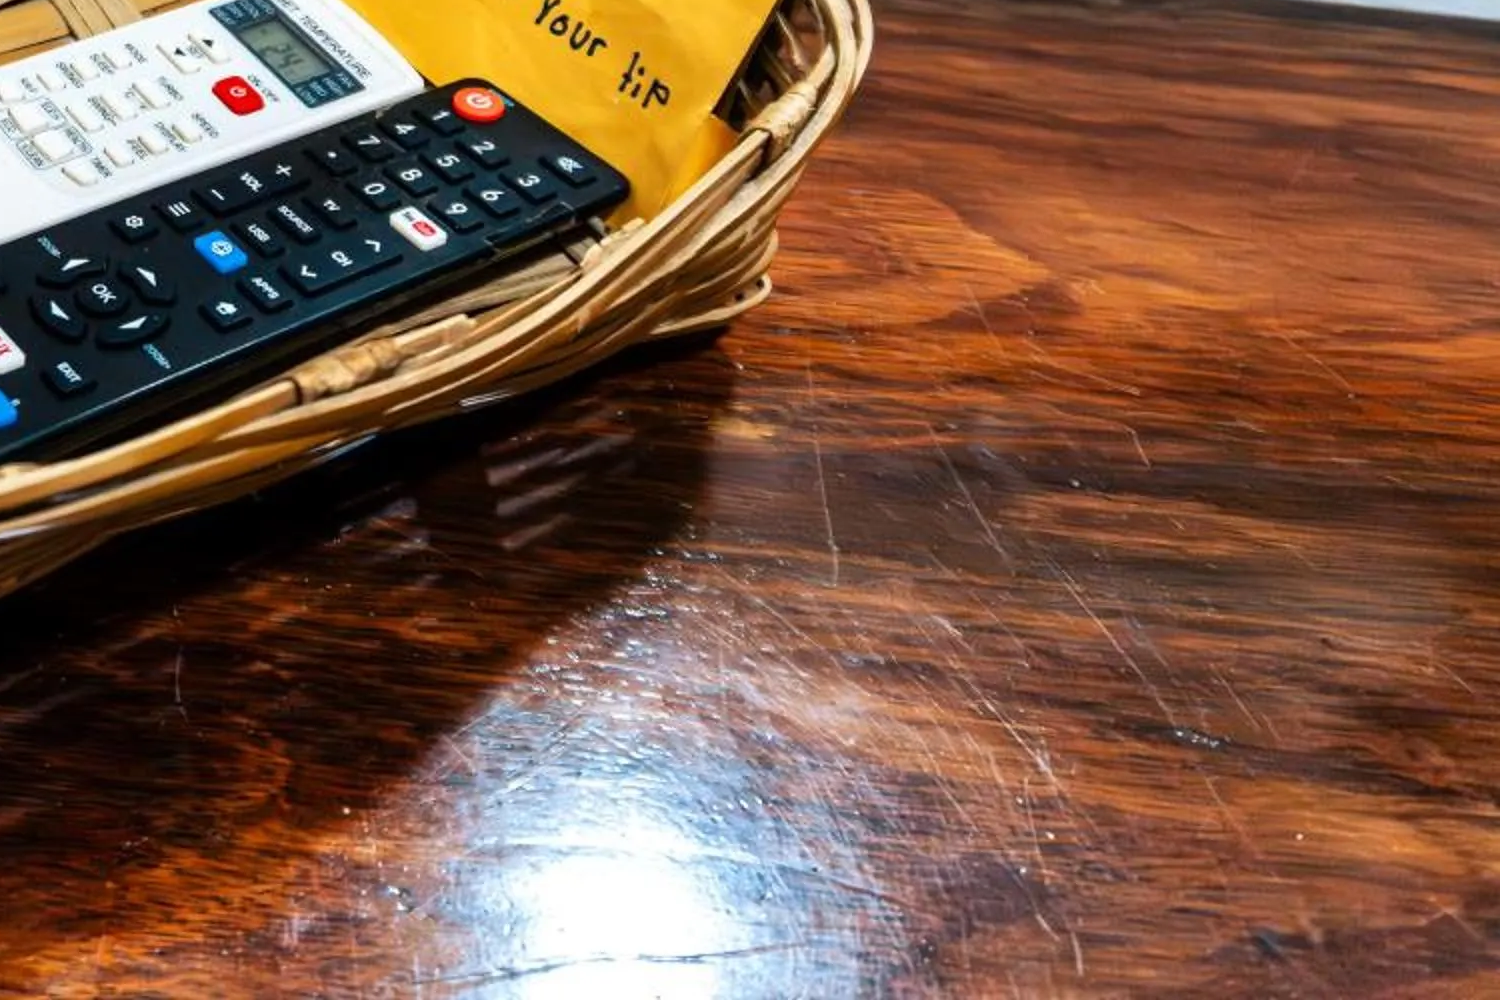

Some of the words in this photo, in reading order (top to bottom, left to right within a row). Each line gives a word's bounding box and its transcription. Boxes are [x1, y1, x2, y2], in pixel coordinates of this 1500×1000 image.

[300, 15, 372, 79] TEMPERATURE
[432, 110, 450, 122] 1
[396, 123, 416, 135] 4
[357, 134, 381, 146] 7
[471, 141, 496, 156] 2
[436, 154, 460, 168] 5
[400, 168, 423, 182] 8
[517, 174, 541, 188] 3
[240, 172, 263, 193] VOL
[363, 183, 386, 196] 0
[480, 189, 505, 202] 6
[323, 198, 341, 212] TV
[446, 202, 468, 215] 9
[277, 205, 314, 234] SOURCE
[248, 223, 271, 243] USB
[331, 250, 353, 268] CH
[91, 283, 117, 304] OK
[251, 277, 280, 300] APPS
[56, 361, 83, 383] EXIT
